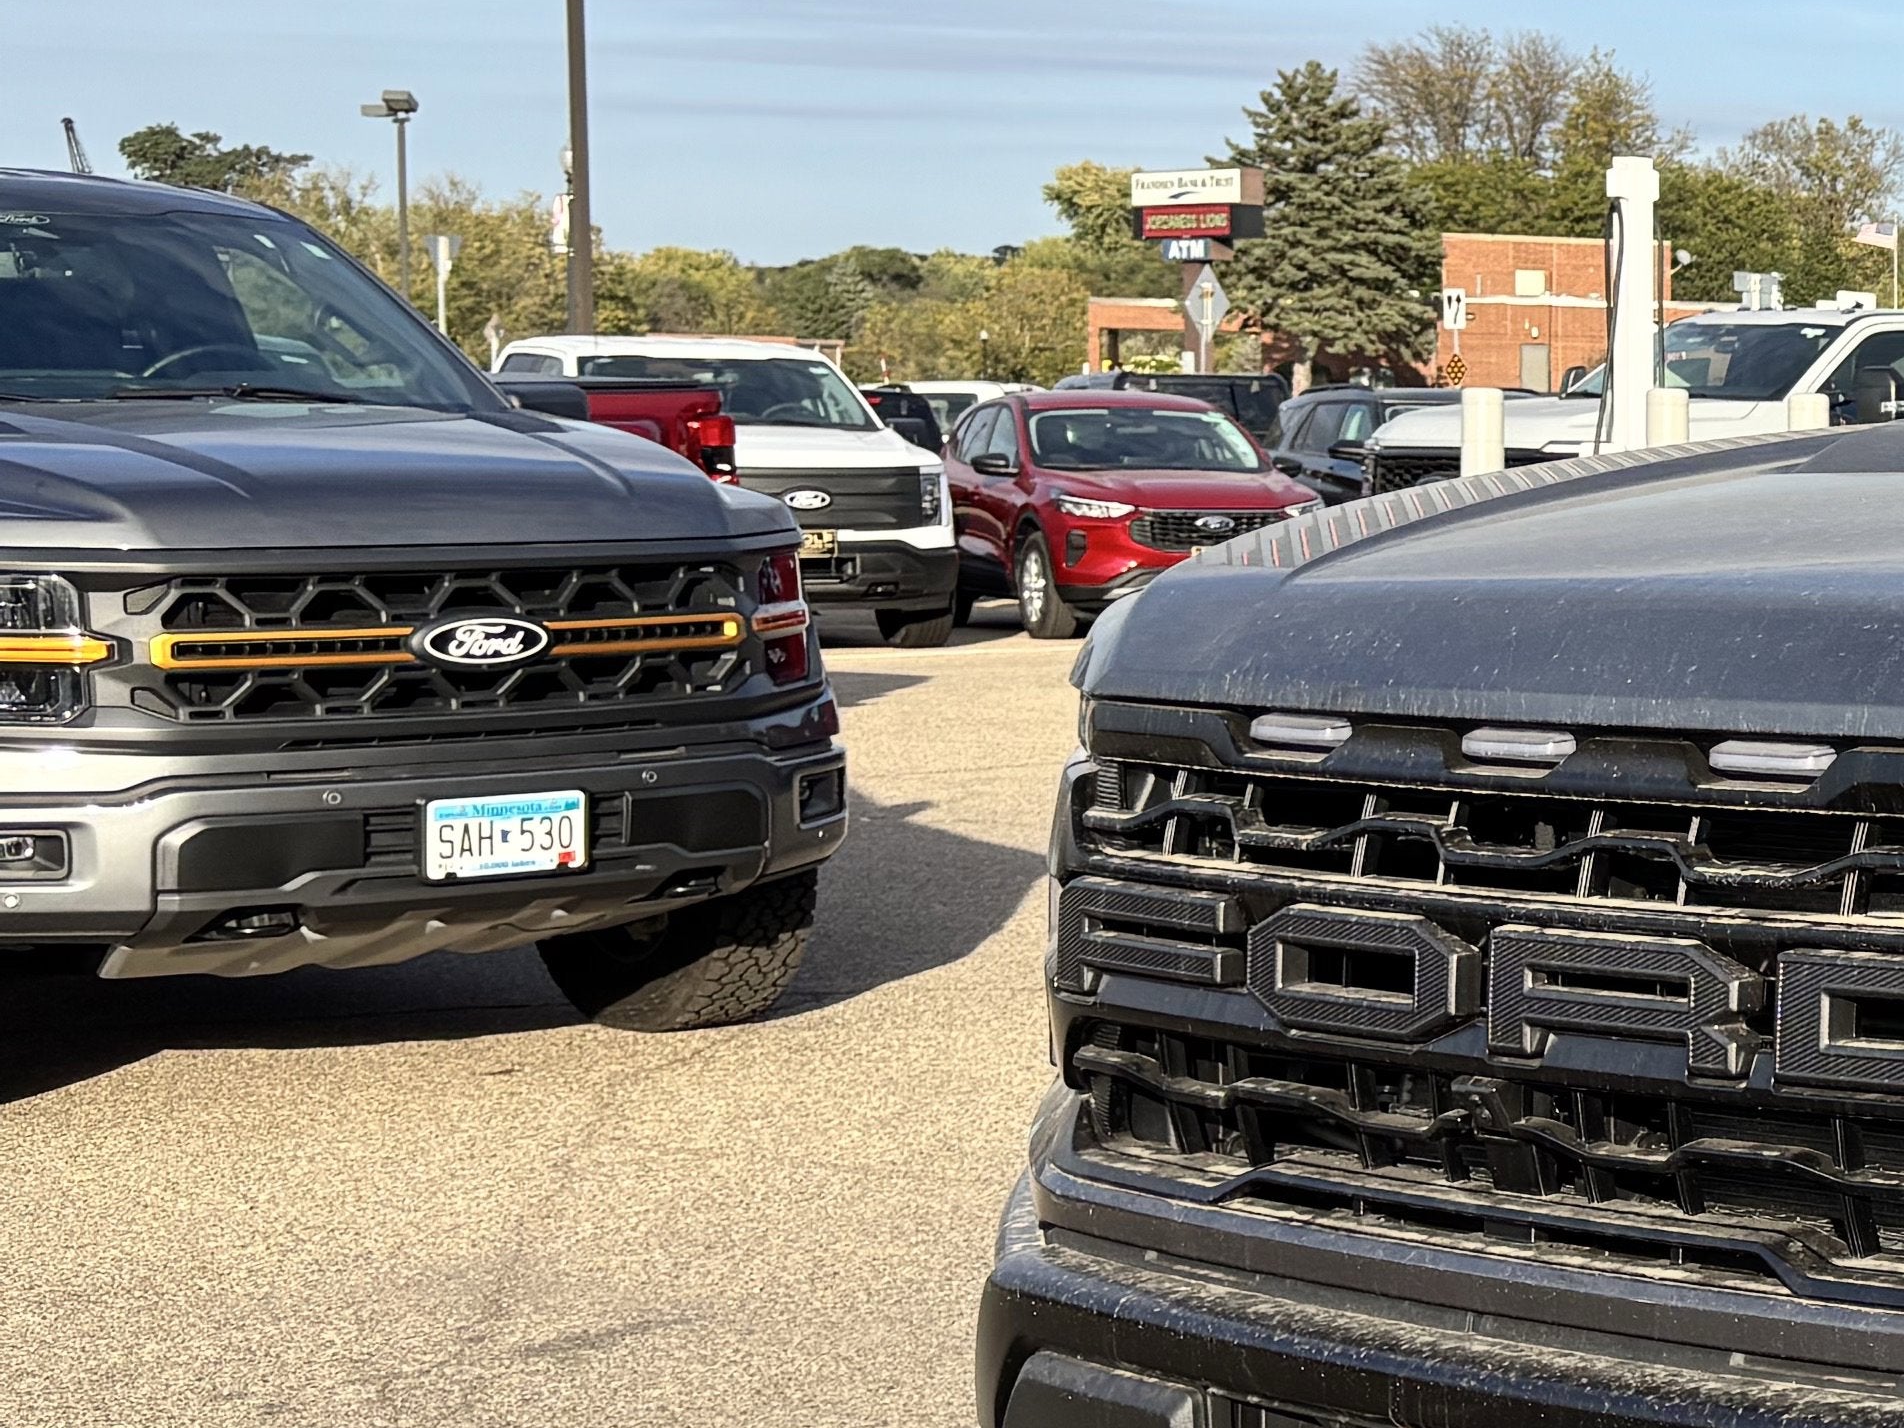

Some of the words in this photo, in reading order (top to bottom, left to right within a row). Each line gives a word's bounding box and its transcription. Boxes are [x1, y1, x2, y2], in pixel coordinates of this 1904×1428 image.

[1168, 239, 1205, 259] ATM
[448, 624, 525, 657] Ford
[472, 802, 543, 817] Minnesota
[439, 820, 494, 859] SAH
[520, 815, 573, 852] 530
